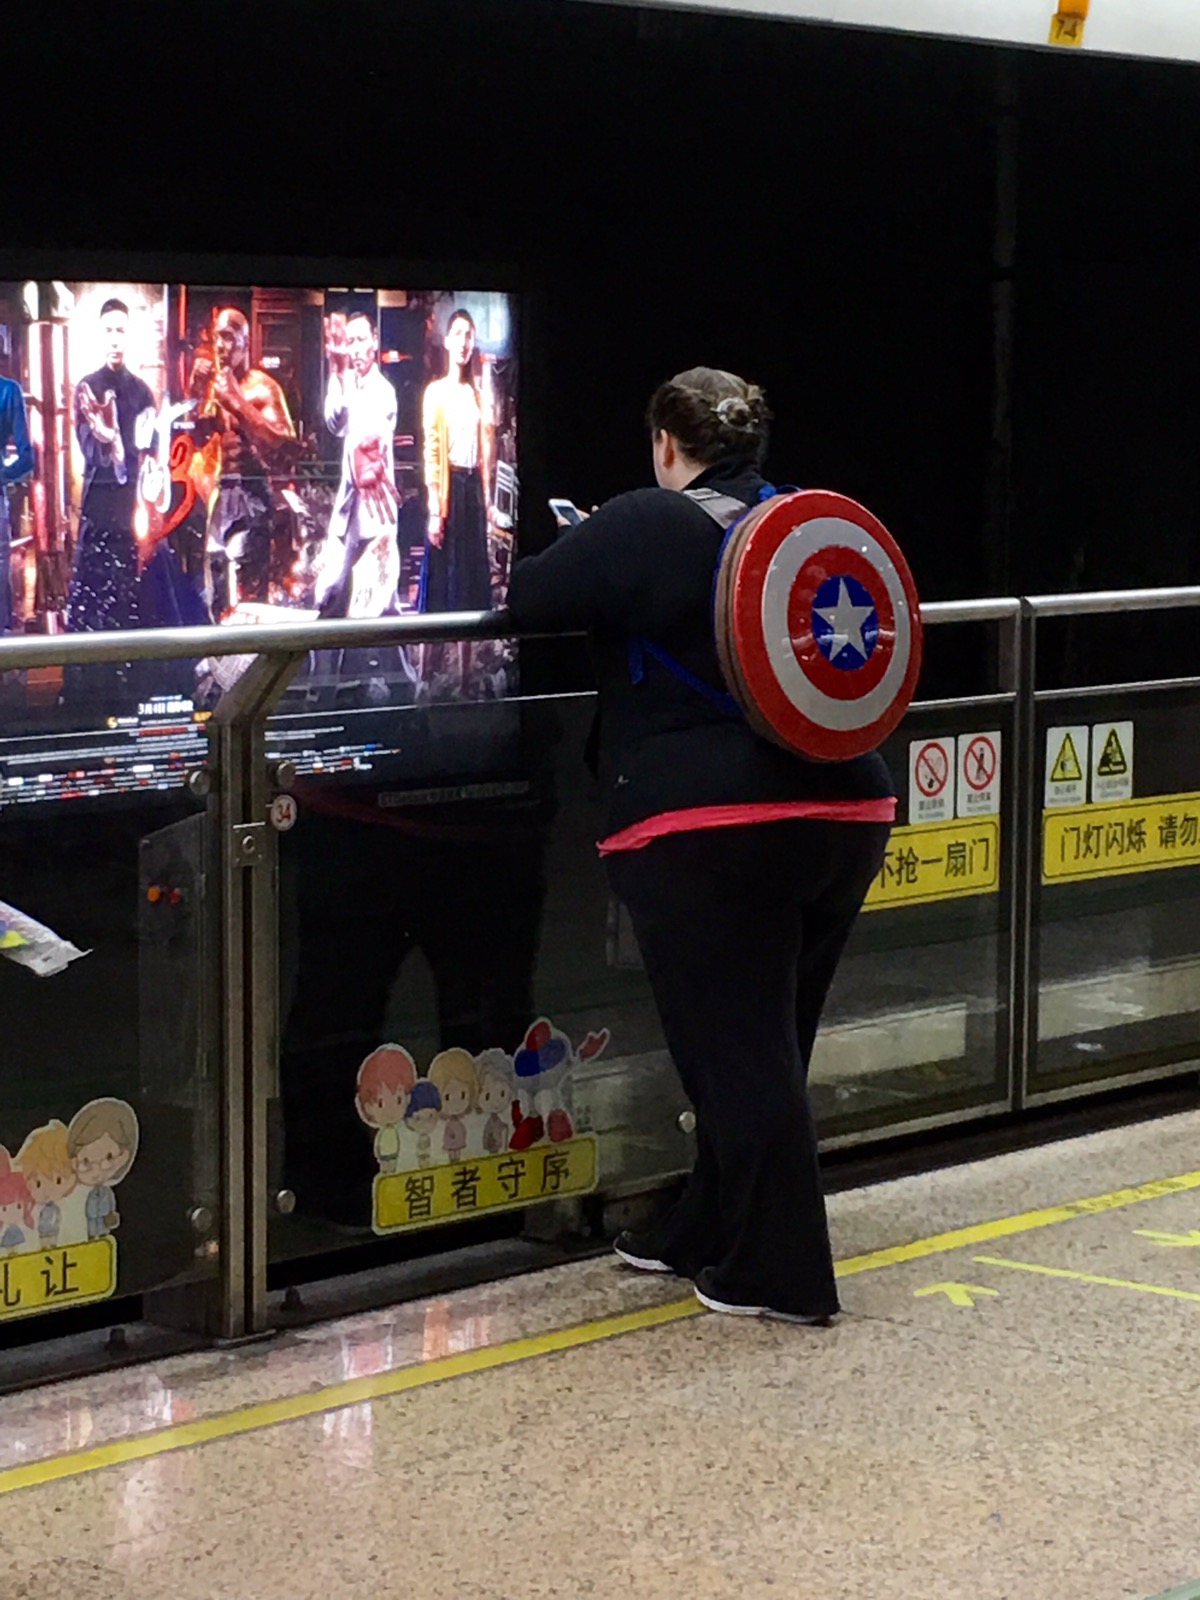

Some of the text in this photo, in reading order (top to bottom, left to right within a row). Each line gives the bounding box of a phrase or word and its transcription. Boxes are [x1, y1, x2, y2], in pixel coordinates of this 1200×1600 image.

[275, 802, 292, 824] 34
[1061, 812, 1199, 863] 门灯闪烁 请勿
[404, 1149, 571, 1219] 智者守序
